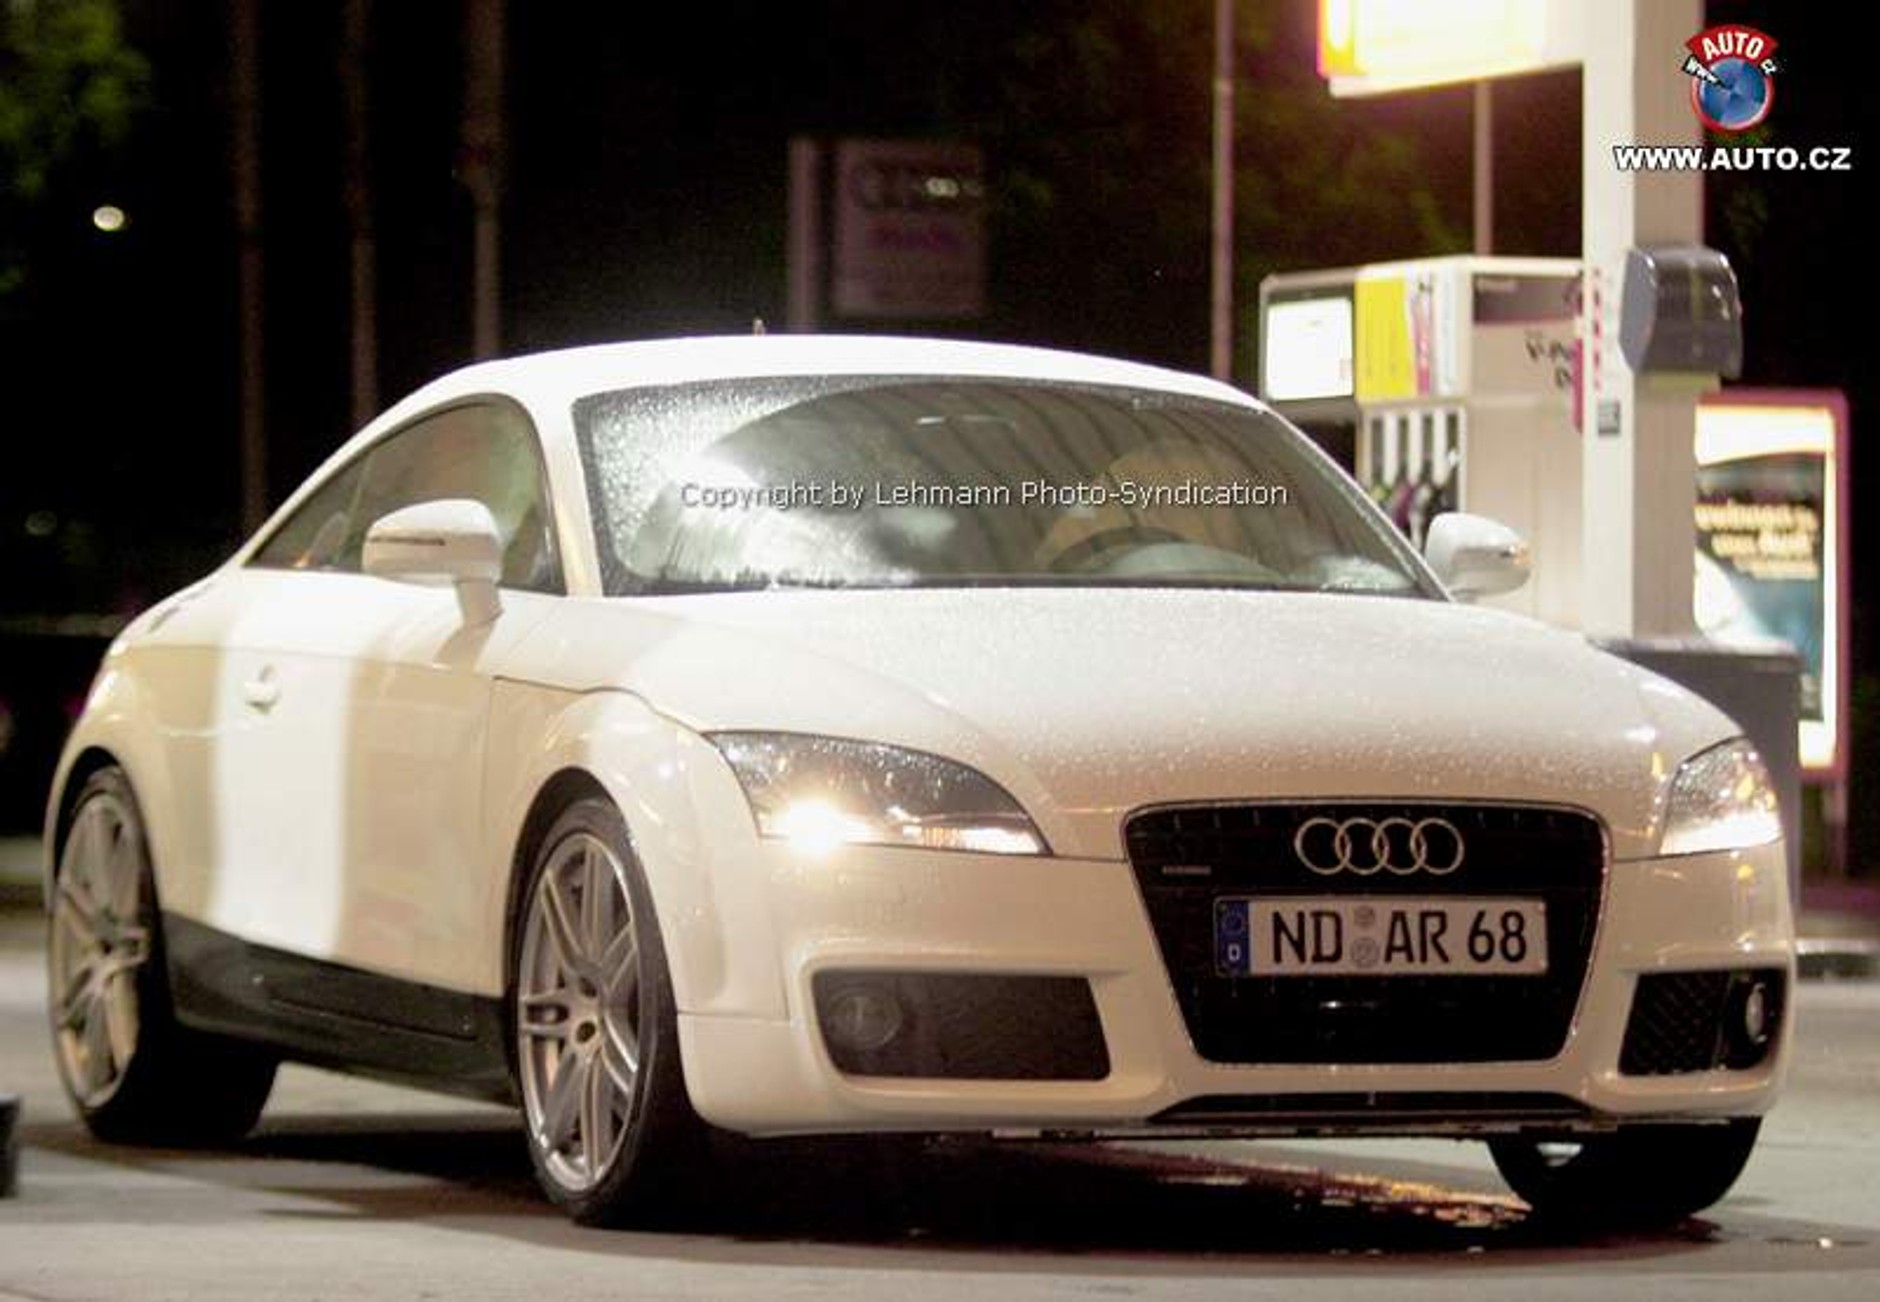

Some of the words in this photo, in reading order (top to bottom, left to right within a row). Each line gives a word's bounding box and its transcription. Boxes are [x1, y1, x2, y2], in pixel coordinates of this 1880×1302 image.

[1271, 910, 1343, 964] ND
[1384, 910, 1450, 964] AR
[1467, 910, 1527, 963] 68
